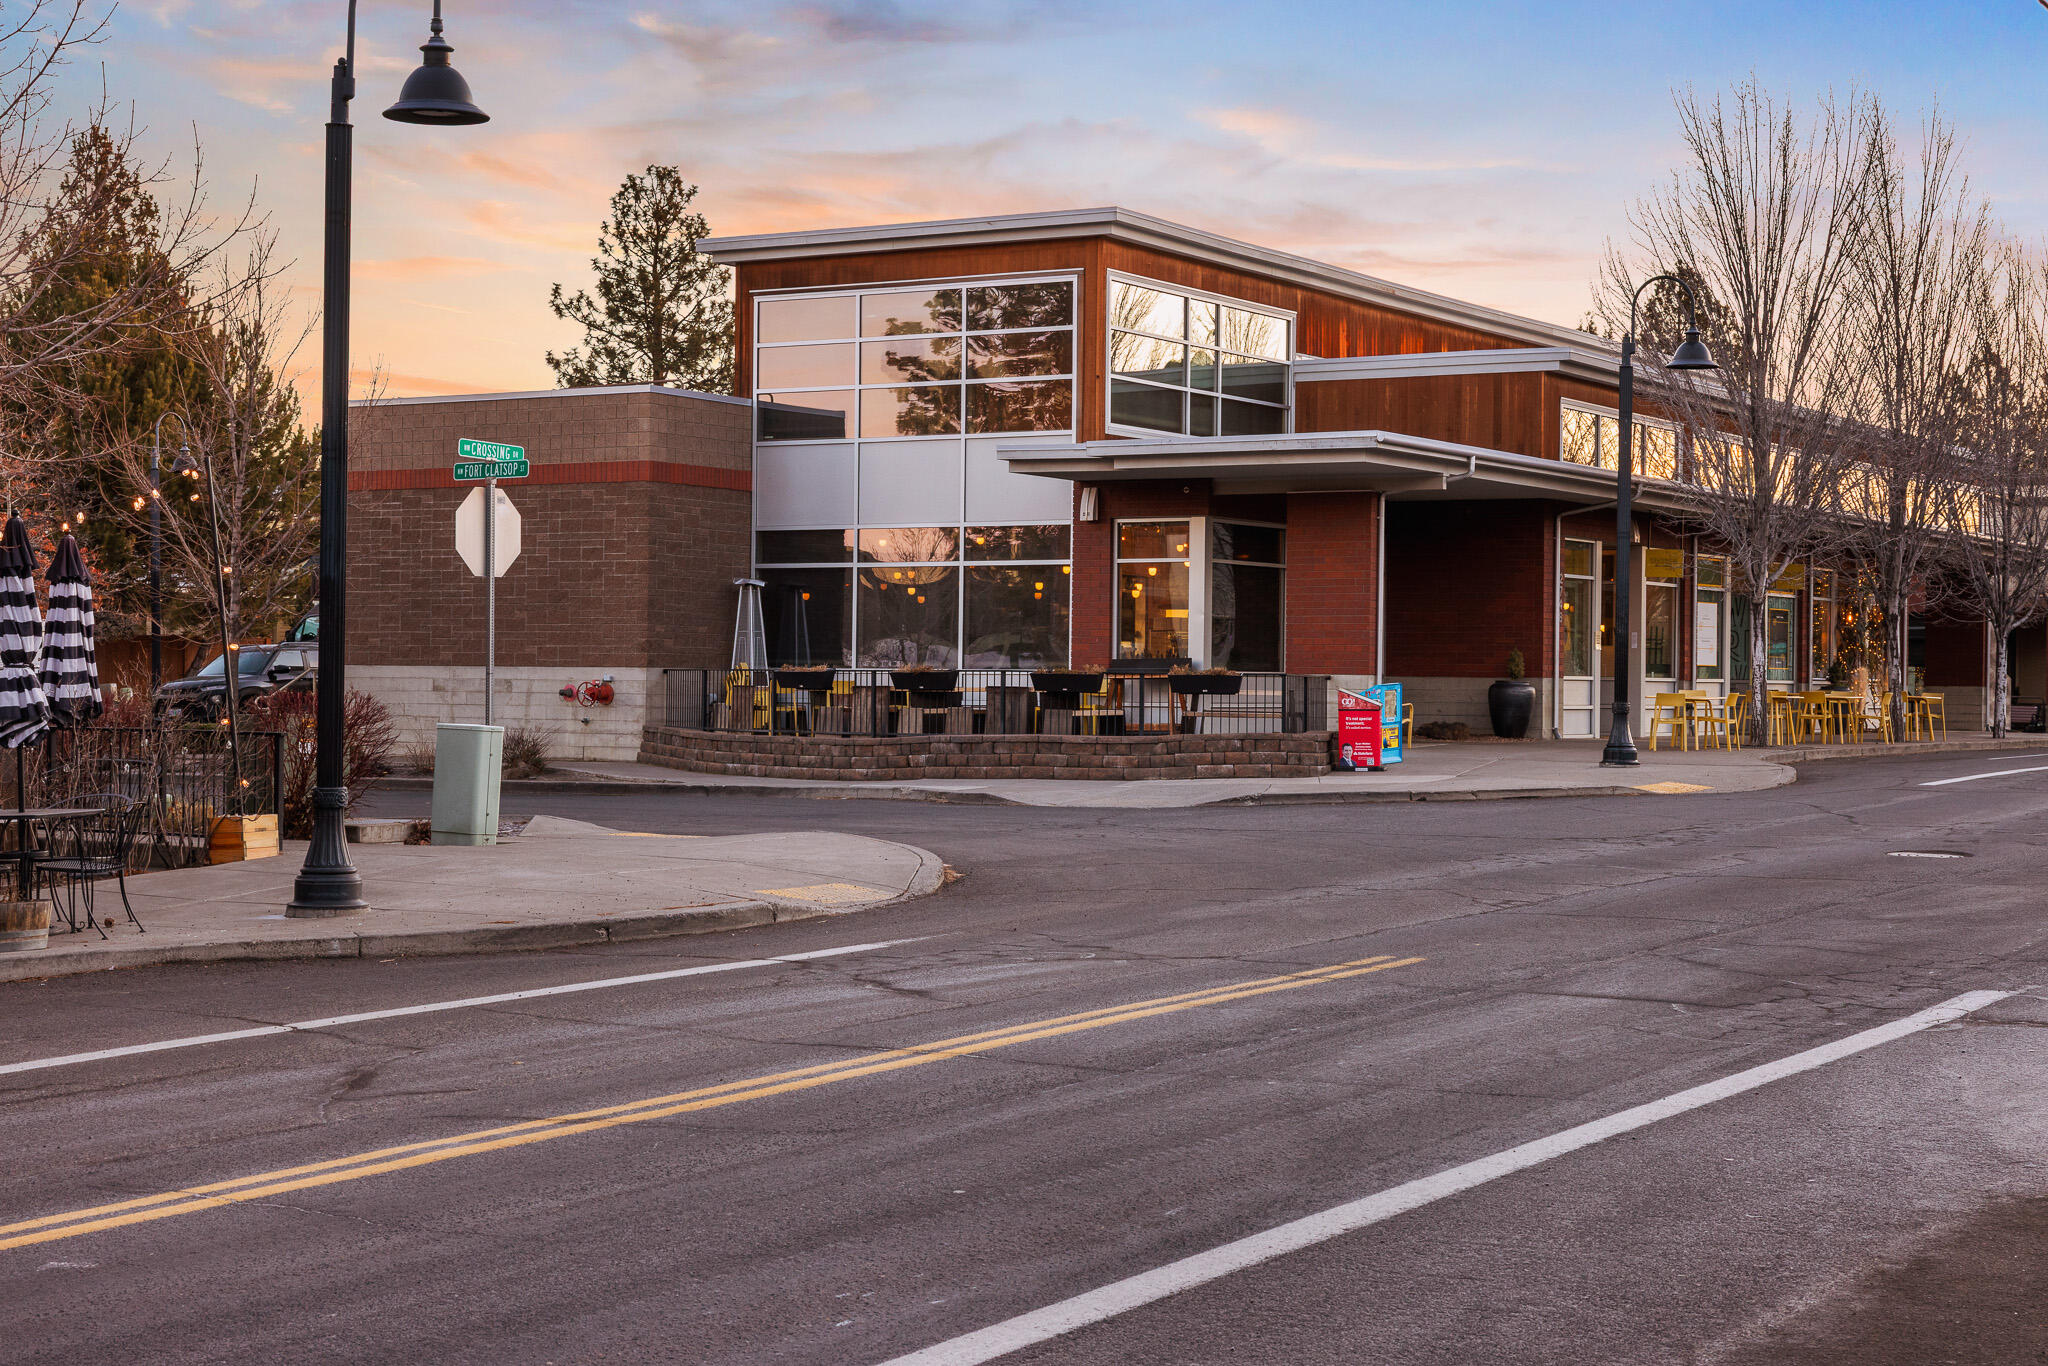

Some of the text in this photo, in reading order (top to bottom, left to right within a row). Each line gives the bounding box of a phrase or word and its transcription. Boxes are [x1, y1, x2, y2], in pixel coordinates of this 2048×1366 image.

[471, 443, 511, 459] CROSSING
[464, 465, 482, 477] FORT
[485, 462, 518, 477] CLATSOP
